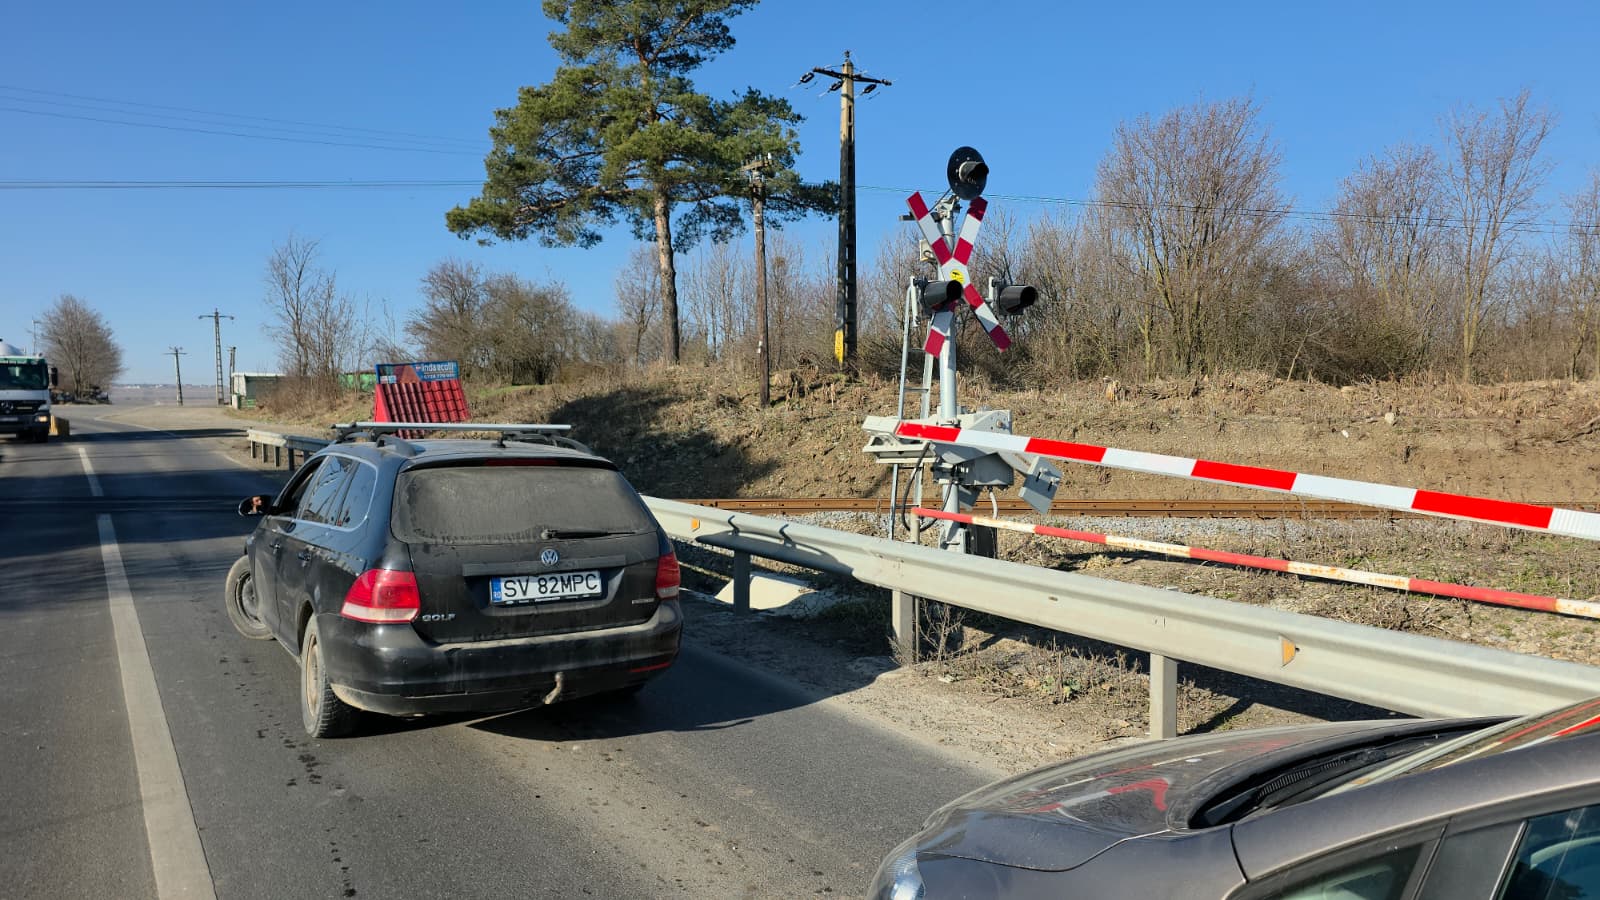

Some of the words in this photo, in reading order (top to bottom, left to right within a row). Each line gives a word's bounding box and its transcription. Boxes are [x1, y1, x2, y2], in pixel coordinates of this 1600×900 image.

[503, 576, 530, 597] SV
[537, 573, 598, 595] 82MPC
[422, 613, 456, 622] GOLF
